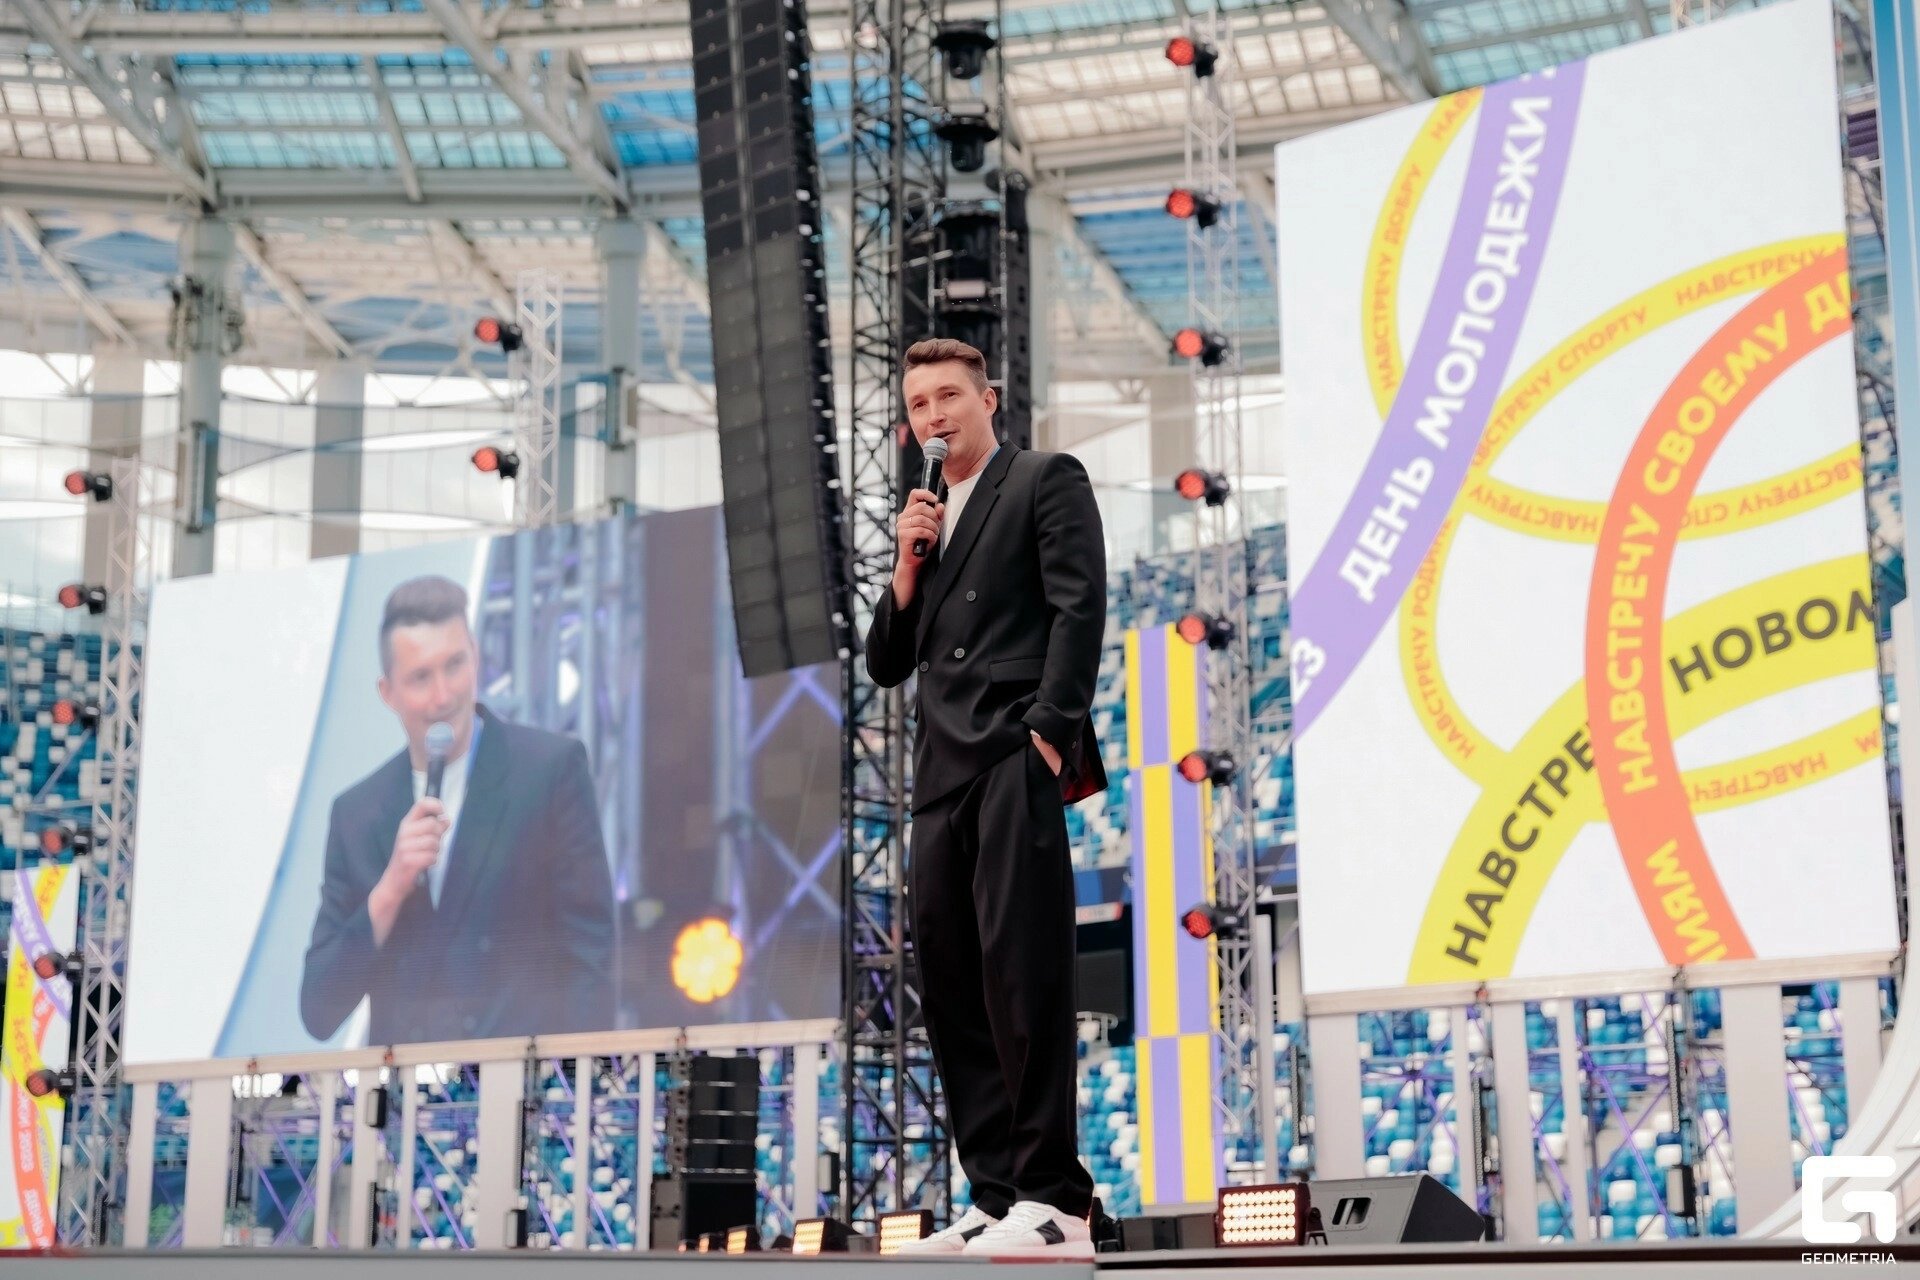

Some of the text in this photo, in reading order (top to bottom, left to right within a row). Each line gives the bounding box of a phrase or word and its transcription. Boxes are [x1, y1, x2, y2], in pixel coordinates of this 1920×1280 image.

[1338, 456, 1435, 604] ДЕНЬ
[1414, 97, 1552, 450] МОЛОДЕЖИ
[1371, 163, 1422, 391] НАВСТРЕЧУ ДОБРУ
[1471, 305, 1648, 467] АВСТРЕЧУ СПОРТУ
[1469, 484, 1599, 534] НАВСТРЕЧУ
[1606, 502, 1660, 795] НАВСТРЕЧУ
[1643, 308, 1790, 496] СВОЕМУ
[1738, 457, 1863, 516] АВСТРЕЧУ
[1411, 625, 1476, 759] НАВСТРЕЧУ
[1445, 725, 1594, 967] НАВСТРЕ
[1687, 752, 1828, 802] НАВСТРЕЧ
